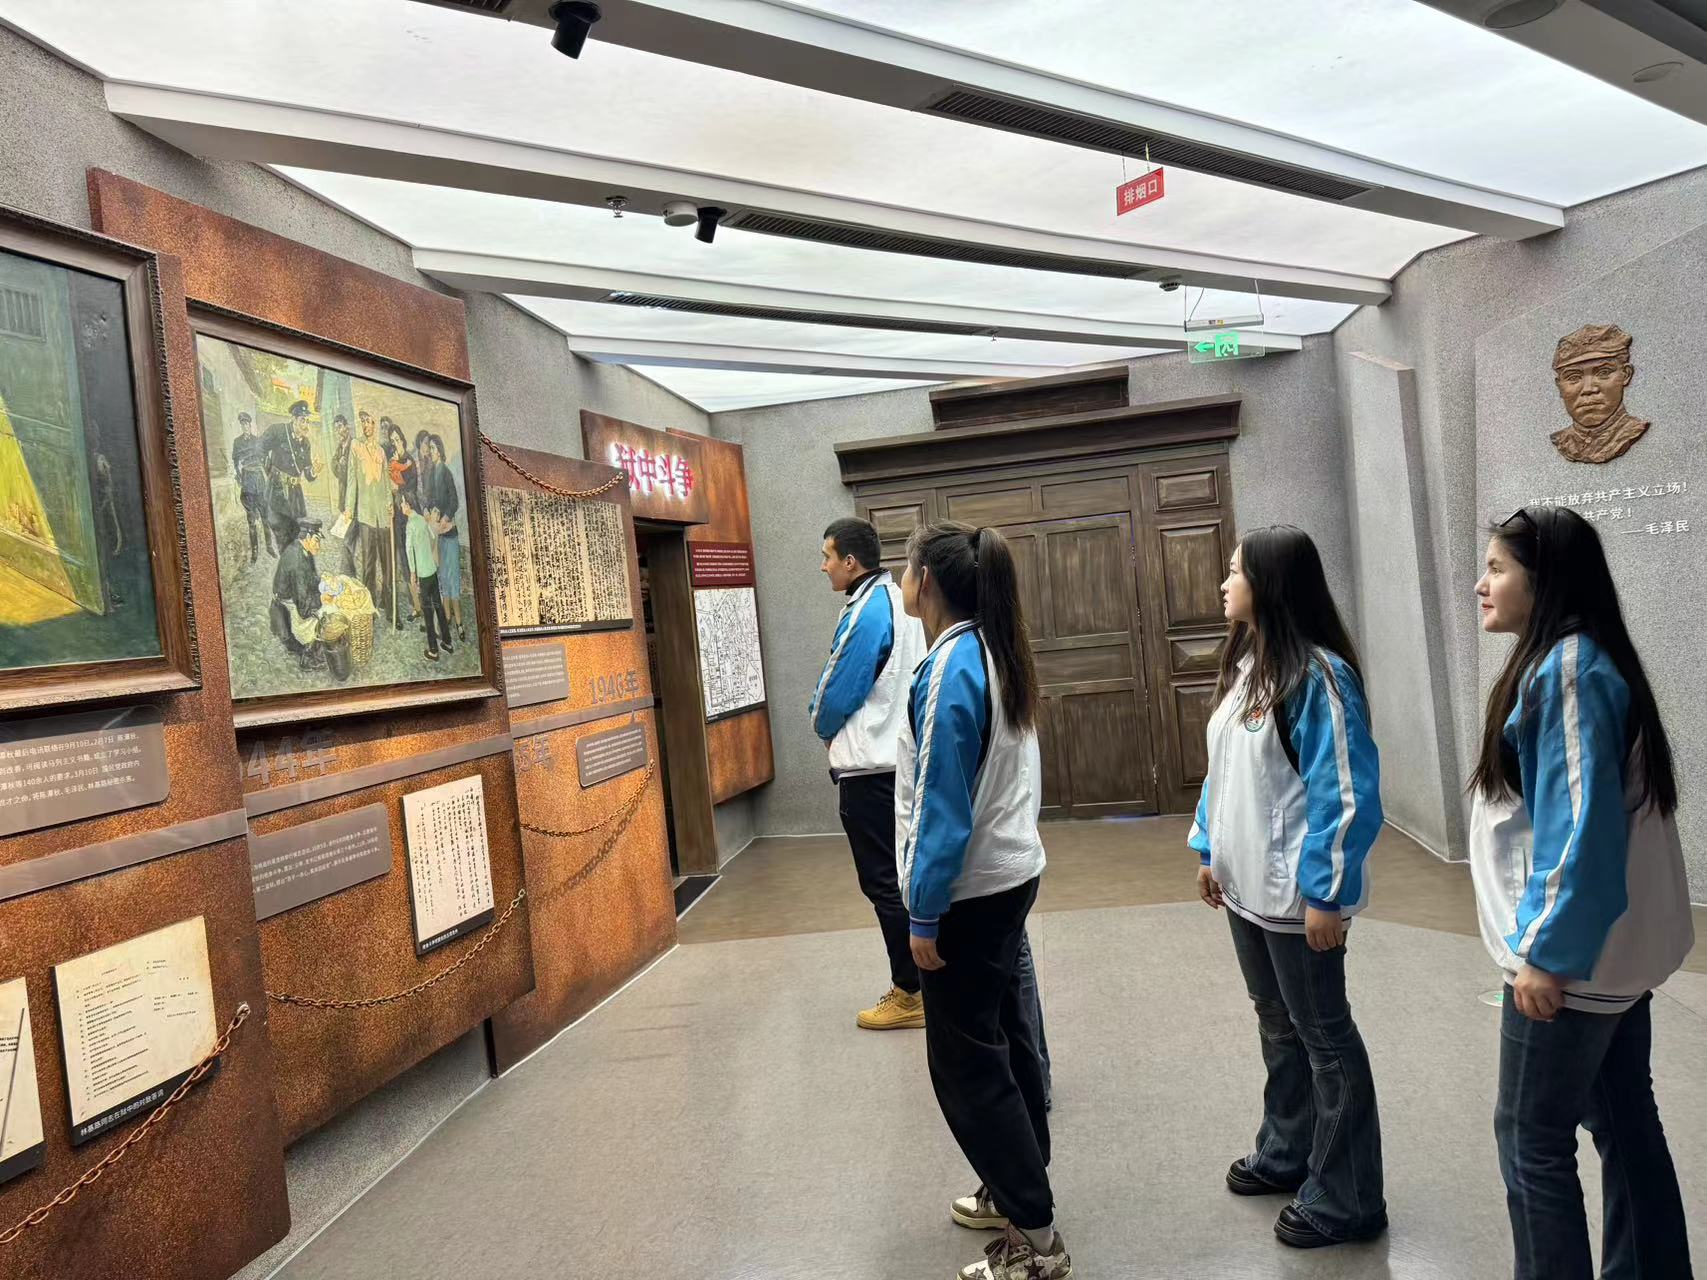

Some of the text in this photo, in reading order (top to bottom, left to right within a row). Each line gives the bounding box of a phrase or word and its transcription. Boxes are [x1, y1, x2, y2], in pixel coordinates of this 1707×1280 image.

[1123, 179, 1158, 206] 排烟口
[615, 442, 693, 497] 狱中斗争
[592, 670, 640, 704] 1946年
